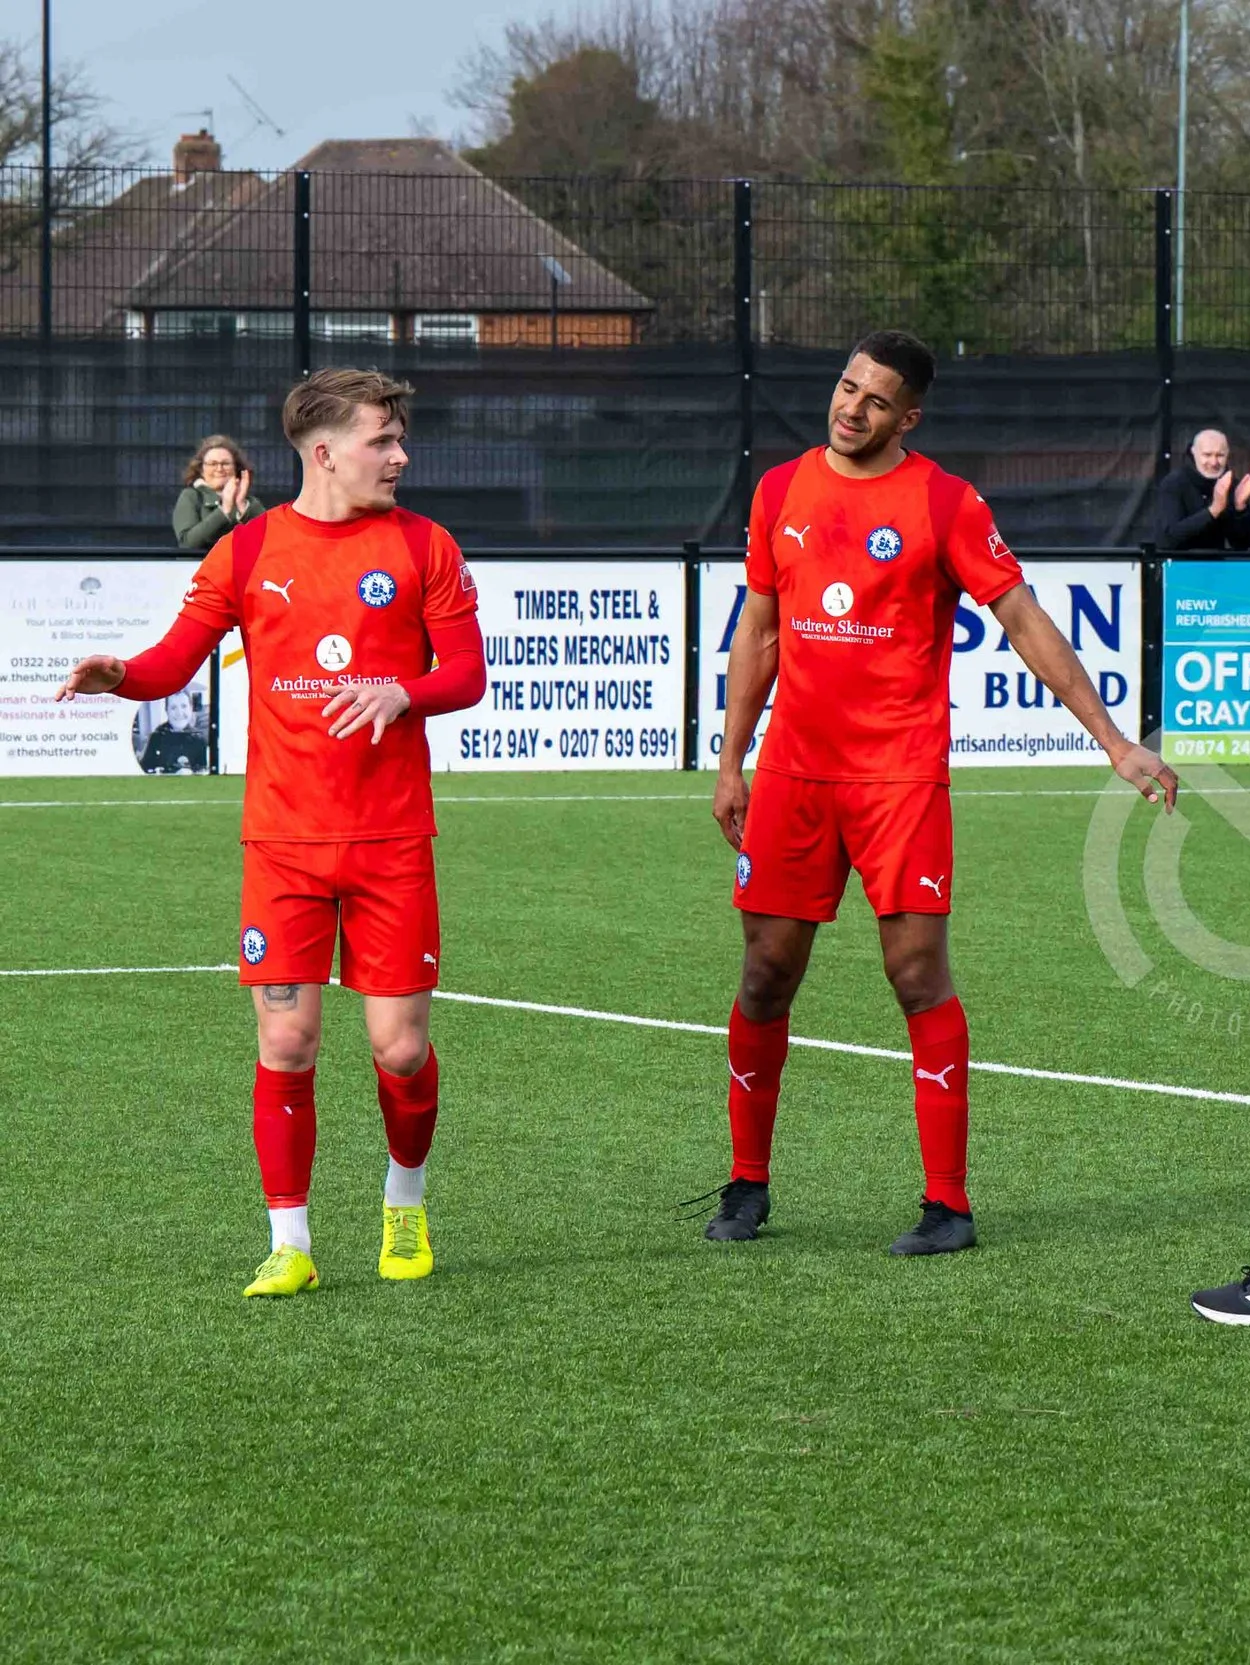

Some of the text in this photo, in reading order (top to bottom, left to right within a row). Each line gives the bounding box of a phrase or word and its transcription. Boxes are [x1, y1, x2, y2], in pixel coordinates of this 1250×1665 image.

[514, 589, 660, 625] TIMBER, STEEL &
[1176, 600, 1217, 611] NEWLY
[838, 620, 894, 638] Skinner
[486, 635, 670, 666] UILDERS MERCHANTS
[11, 657, 44, 667] 01322
[271, 676, 333, 692] Andrew
[491, 680, 653, 710] THE DUTCH HOUSE
[984, 672, 1127, 708] BUD
[1174, 700, 1250, 726] CRAY
[82, 731, 119, 740] socials
[460, 728, 501, 759] SE12
[507, 728, 539, 758] 9AY
[560, 728, 599, 757] 0207
[605, 728, 633, 757] 639
[640, 727, 677, 757] 6991
[1174, 741, 1225, 755] 07874
